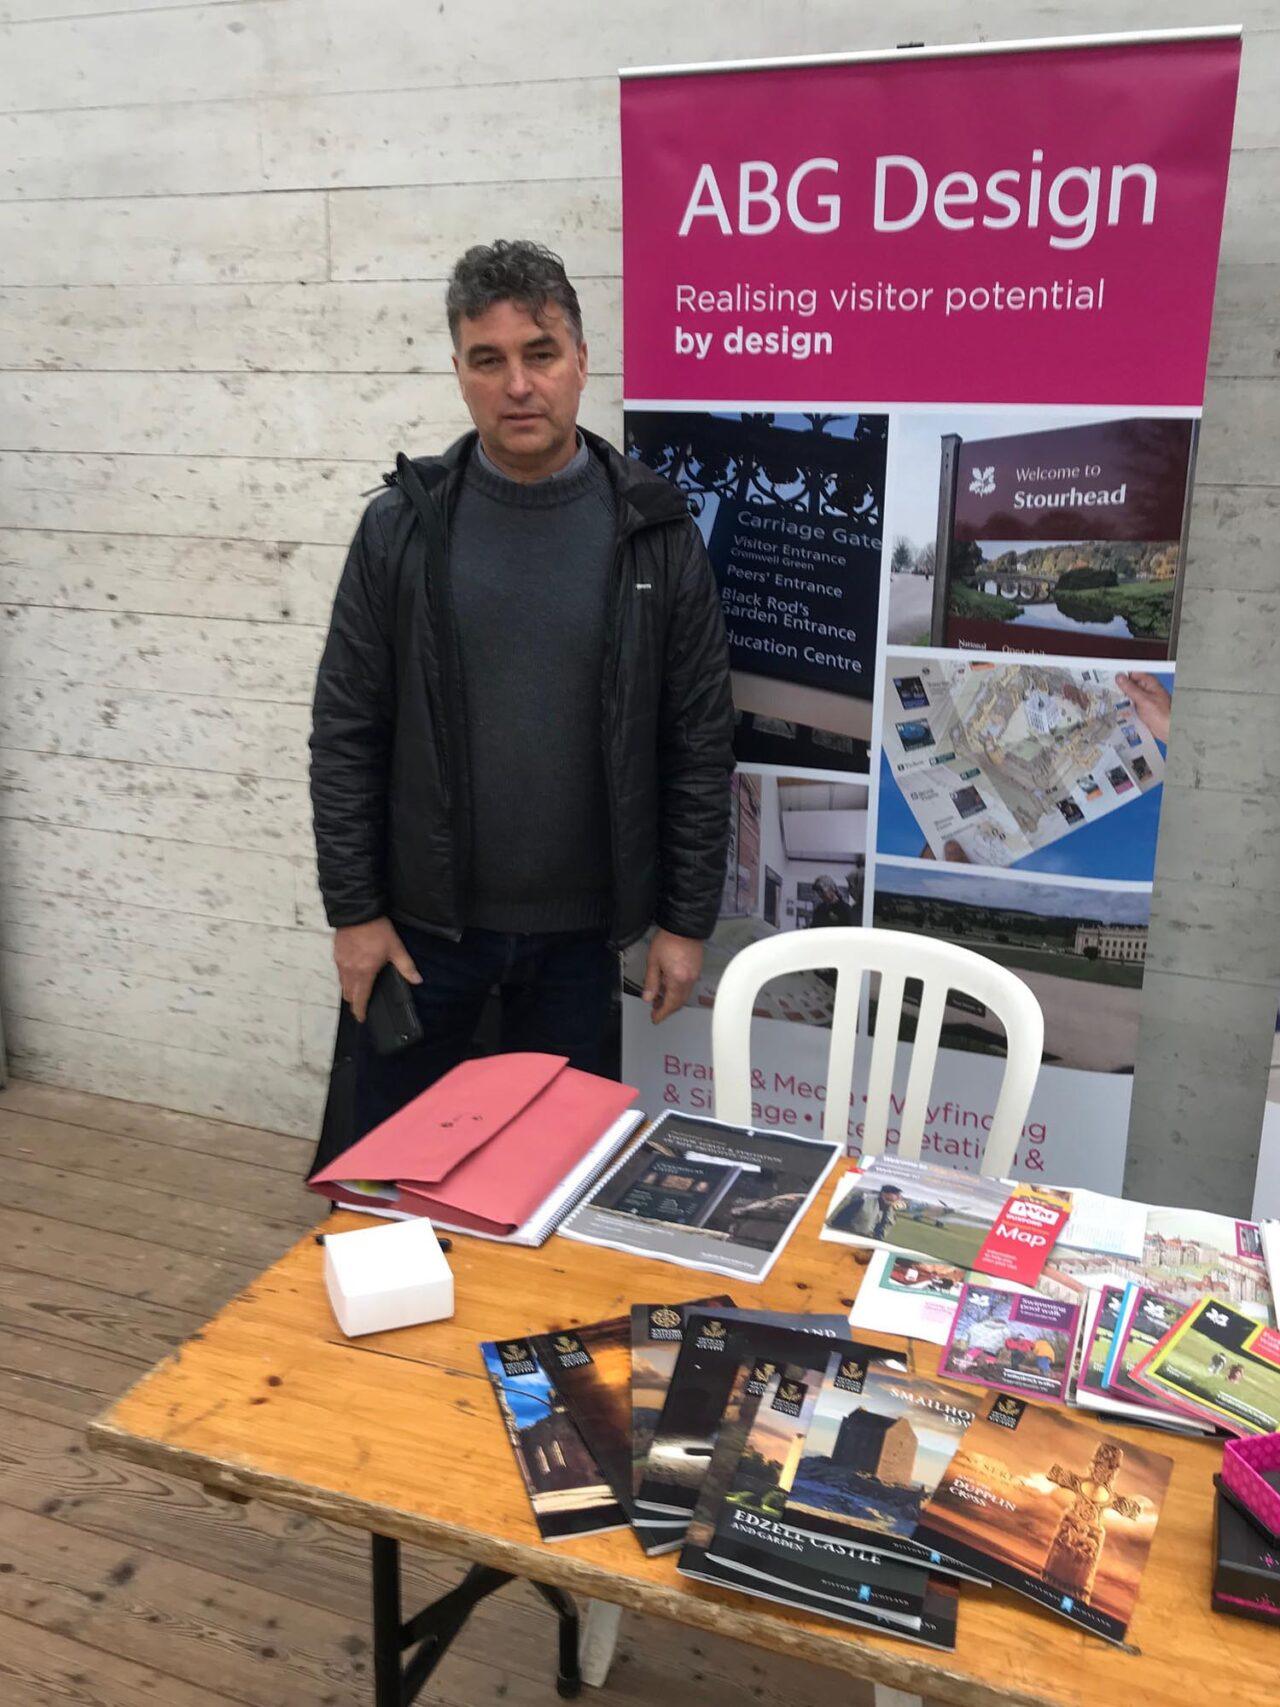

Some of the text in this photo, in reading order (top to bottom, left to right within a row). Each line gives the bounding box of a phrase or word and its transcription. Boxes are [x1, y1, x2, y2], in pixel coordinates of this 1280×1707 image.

[678, 148, 1158, 250] ABG Design
[676, 277, 1106, 316] Realising visitor potential
[675, 324, 833, 360] by design
[1016, 464, 1102, 482] Welcome to
[1013, 483, 1127, 510] Stourhead
[737, 510, 883, 551] Carriage Gate
[730, 547, 815, 572] Cromwell Green
[733, 534, 847, 567] Visitor Entrance
[726, 563, 844, 599] Peers' Entrance
[721, 586, 810, 618] Black Rod's
[721, 600, 857, 643] Garden Entrance
[726, 629, 863, 674] ducation Centre
[664, 1054, 714, 1082] Bra
[750, 1068, 767, 1091] &
[664, 1083, 681, 1105] &
[690, 1087, 798, 1126] Siage
[1024, 1148, 1045, 1172] &
[995, 1223, 1047, 1248] Map
[889, 1387, 976, 1421] SMAILHO
[756, 1530, 805, 1553] GARDEN
[809, 1538, 882, 1566] CASTLE
